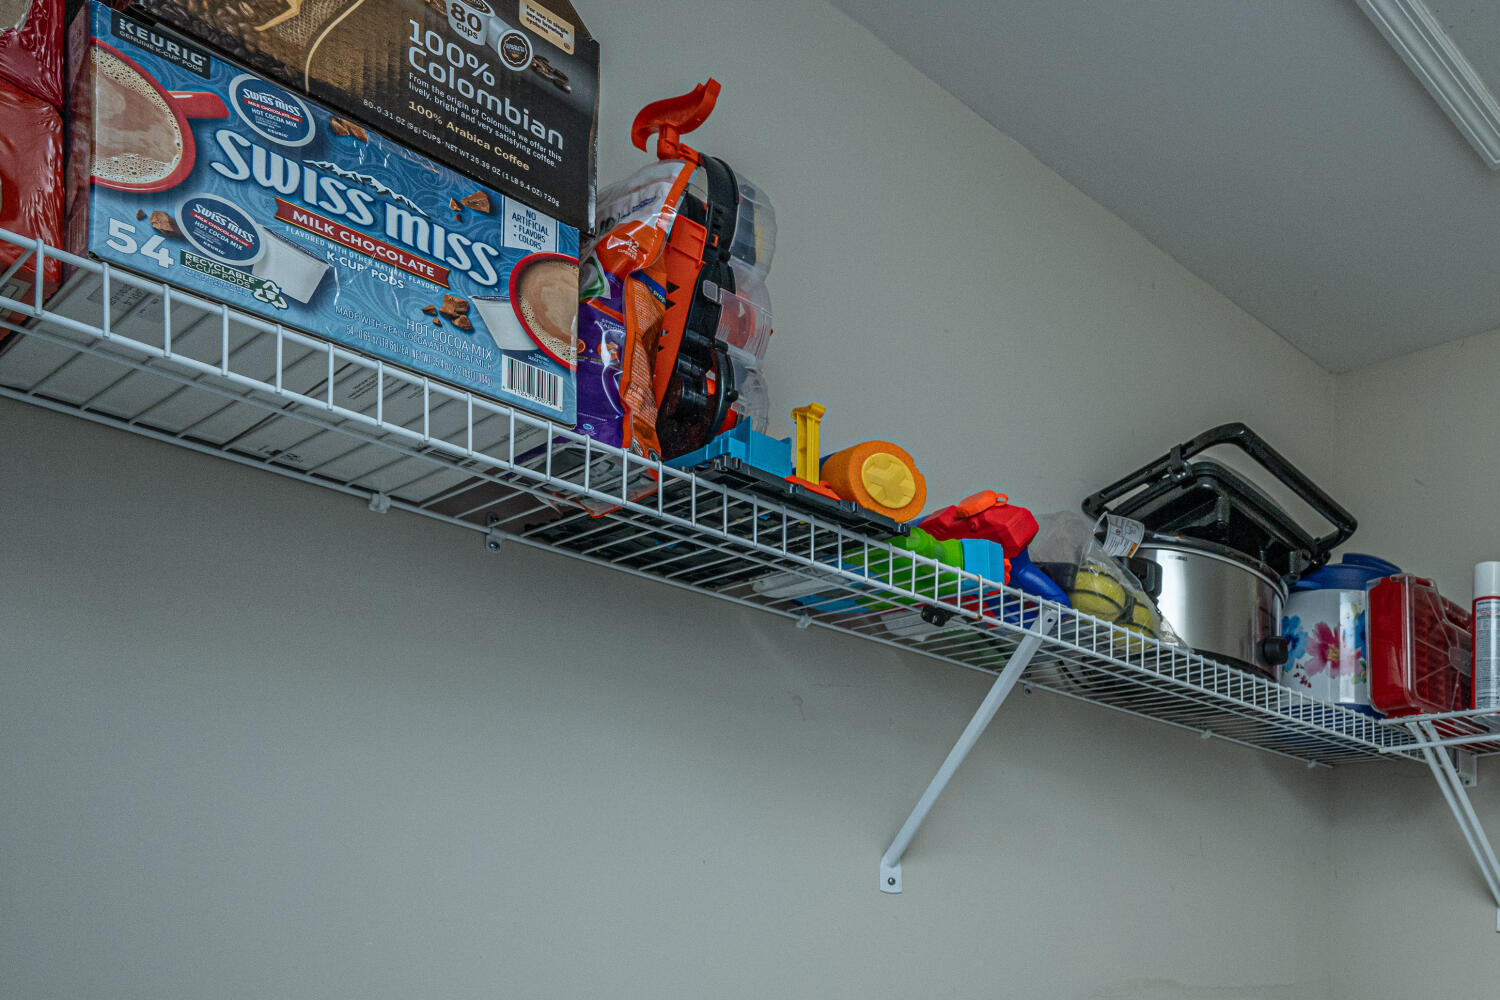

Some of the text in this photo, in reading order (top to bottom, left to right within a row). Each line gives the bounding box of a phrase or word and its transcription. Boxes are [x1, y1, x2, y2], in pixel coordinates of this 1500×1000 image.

[451, 2, 482, 32] 80
[456, 21, 479, 41] cups
[119, 30, 152, 50] GENUINE
[181, 58, 203, 73] PODS
[120, 18, 204, 67] KEURIG
[408, 18, 496, 87] 100%
[408, 46, 564, 150] Colombian
[409, 72, 562, 162] From the origin of Colombia we offer this
[409, 101, 530, 171] 100% Arabica Coffee
[434, 96, 458, 114] bright
[460, 111, 476, 124] and
[478, 120, 494, 134] very
[495, 130, 531, 155] satisfying
[396, 116, 406, 126] OZ
[422, 130, 440, 144] CUPS
[445, 142, 458, 153] NET
[460, 148, 470, 158] WT
[492, 166, 500, 176] OZ
[510, 176, 518, 184] LB
[544, 193, 560, 207] 720g
[193, 204, 254, 244] SWISS MISS
[210, 129, 500, 286] SWISS MISS
[511, 213, 549, 236] ARTIFICIAL
[526, 209, 536, 220] NO
[106, 217, 175, 269] 54
[194, 220, 243, 251] HOT COCOA MIX
[292, 210, 434, 278] MILK CHOCOLATE
[518, 225, 546, 243] FLAVORS
[518, 234, 542, 250] COLORS
[186, 252, 256, 284] RECYCLABLE
[186, 259, 250, 289] K-CUP PODS
[326, 252, 404, 290] K-CUP PODS
[406, 318, 493, 362] HOT COCOA MIX
